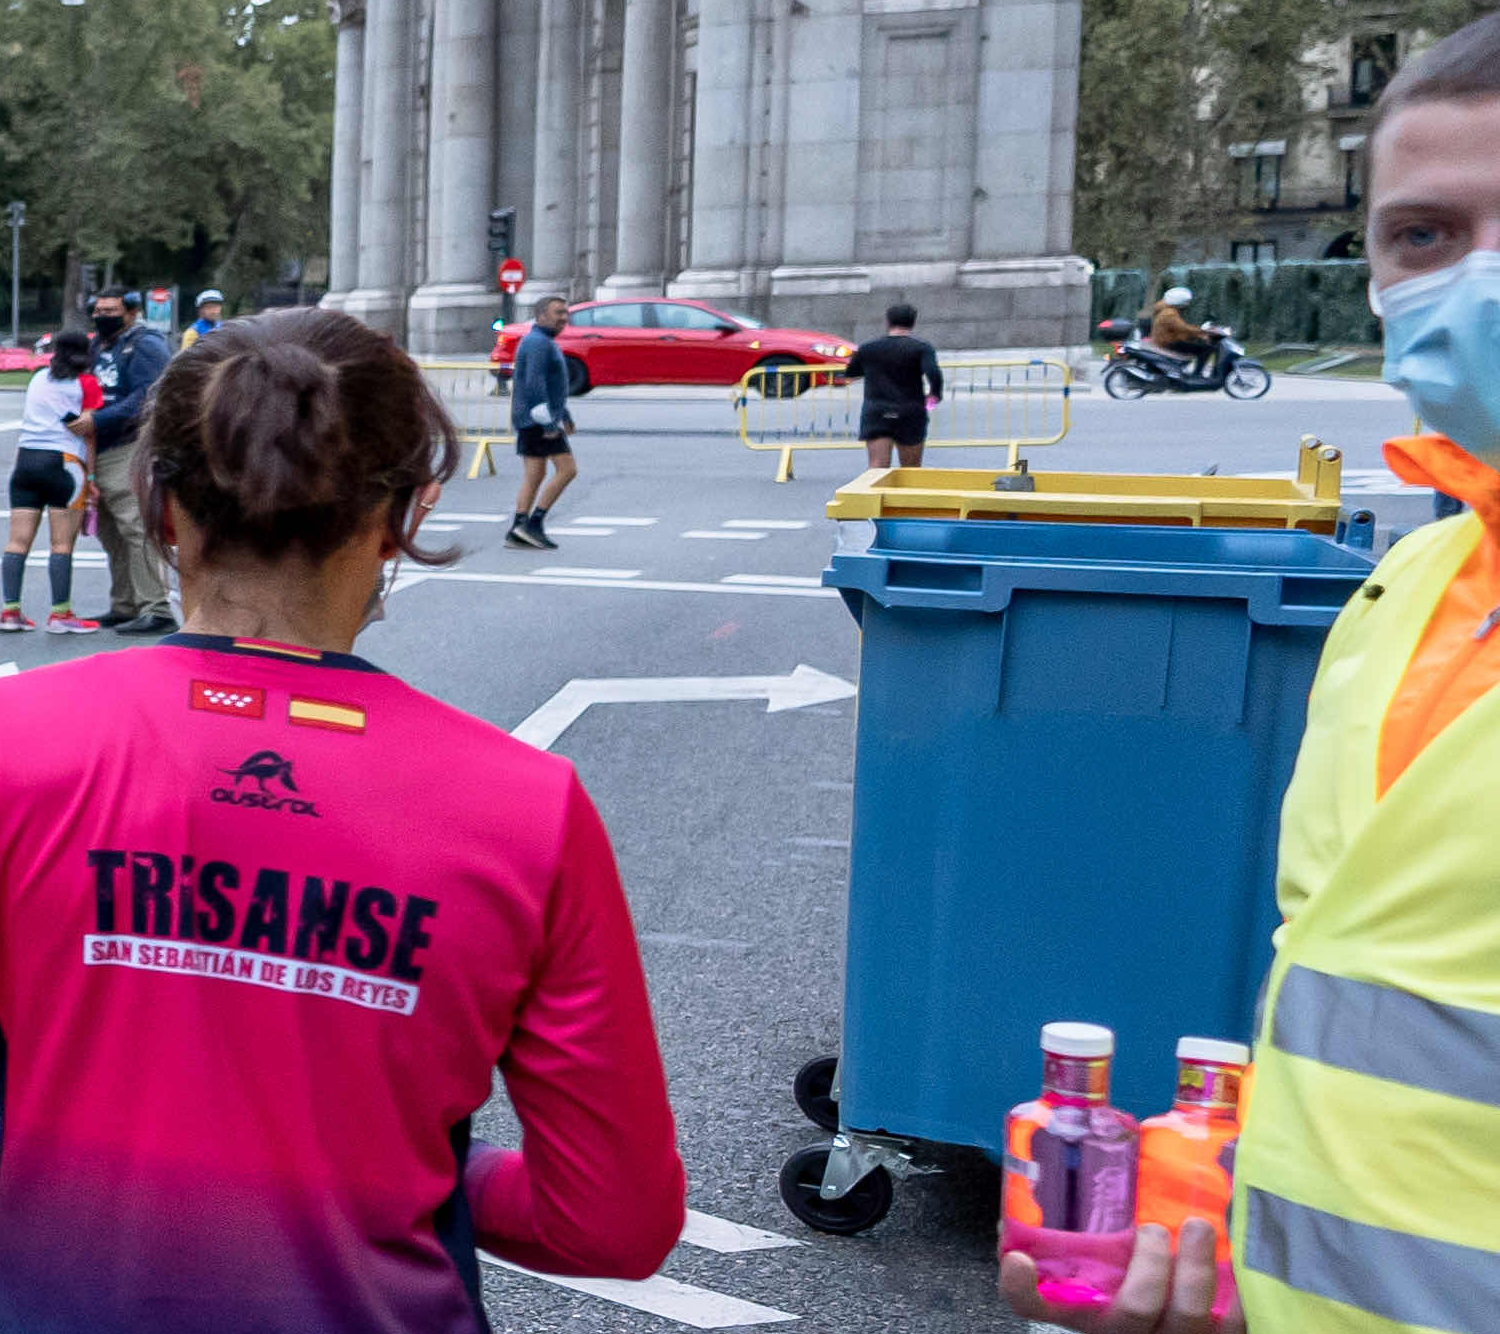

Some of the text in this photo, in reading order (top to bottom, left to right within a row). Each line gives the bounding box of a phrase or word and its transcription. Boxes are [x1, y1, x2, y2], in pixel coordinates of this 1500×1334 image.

[92, 940, 410, 1010] SAN SEBASTIÁN DE LOS REYES
